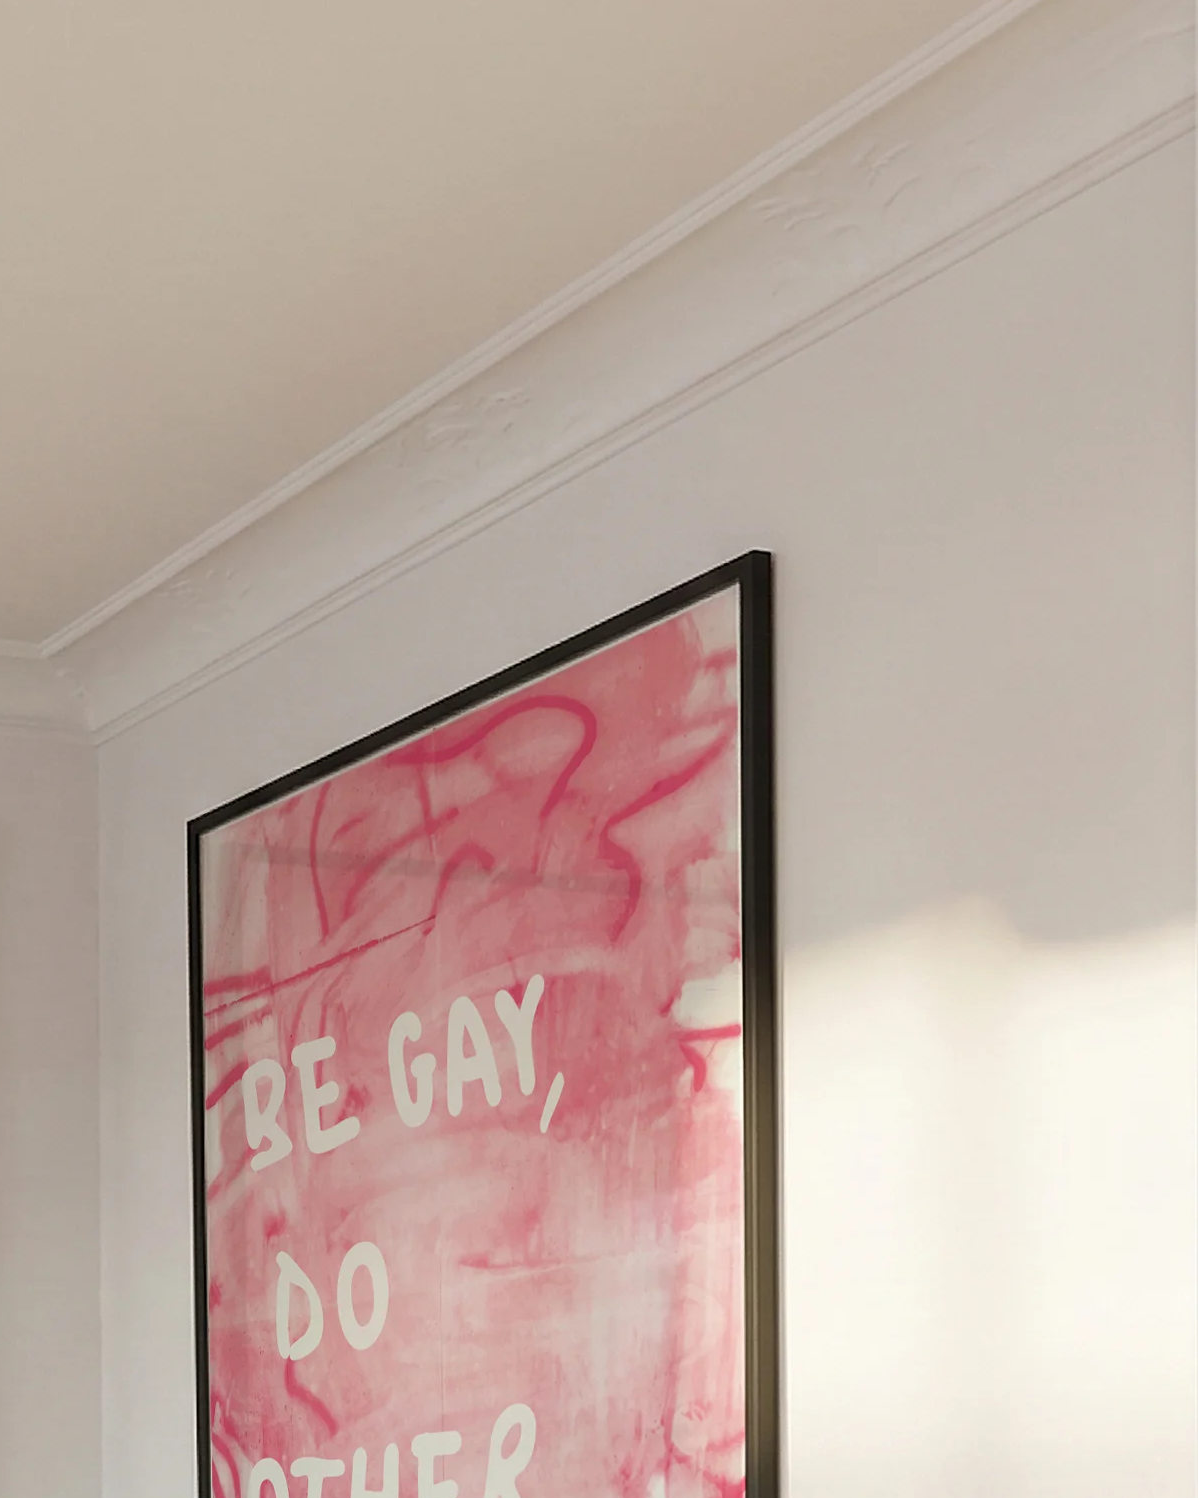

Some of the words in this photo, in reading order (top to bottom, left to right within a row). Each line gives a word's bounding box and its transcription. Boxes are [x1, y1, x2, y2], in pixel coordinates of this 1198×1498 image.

[240, 1036, 361, 1172] BE
[388, 974, 565, 1133] GAY,
[275, 1241, 390, 1361] DO
